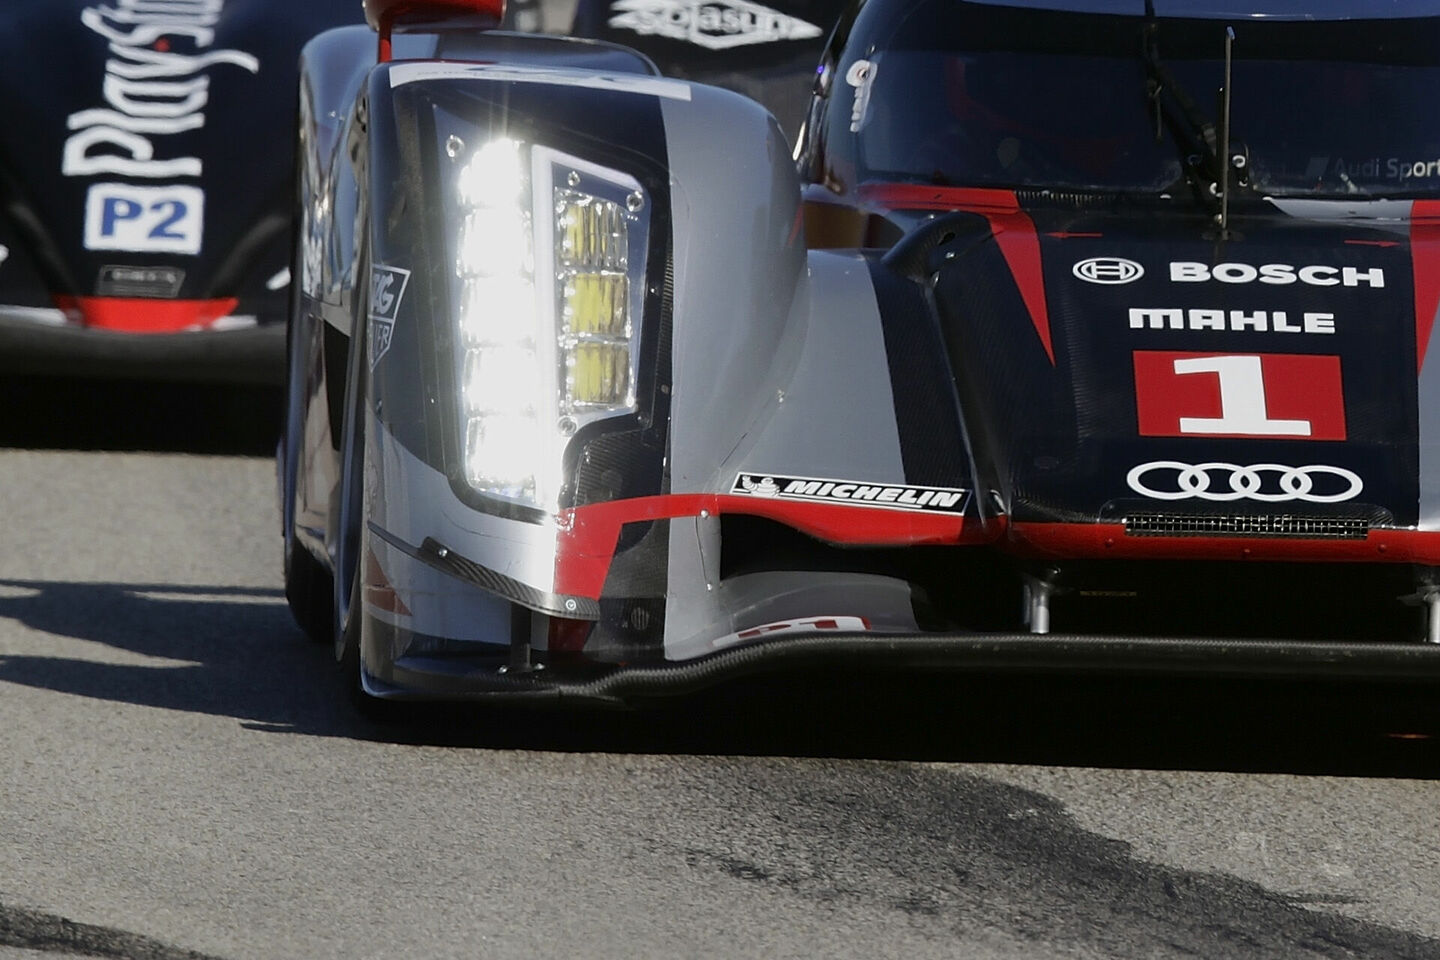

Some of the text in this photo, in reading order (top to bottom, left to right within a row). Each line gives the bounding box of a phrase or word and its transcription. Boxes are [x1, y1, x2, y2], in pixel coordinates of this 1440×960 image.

[1334, 159, 1380, 178] Audi
[101, 197, 188, 239] P2
[1169, 262, 1385, 287] BOSCH
[1129, 308, 1335, 333] MAHLE
[1173, 355, 1312, 436] 1
[783, 480, 962, 508] MICHELIN
